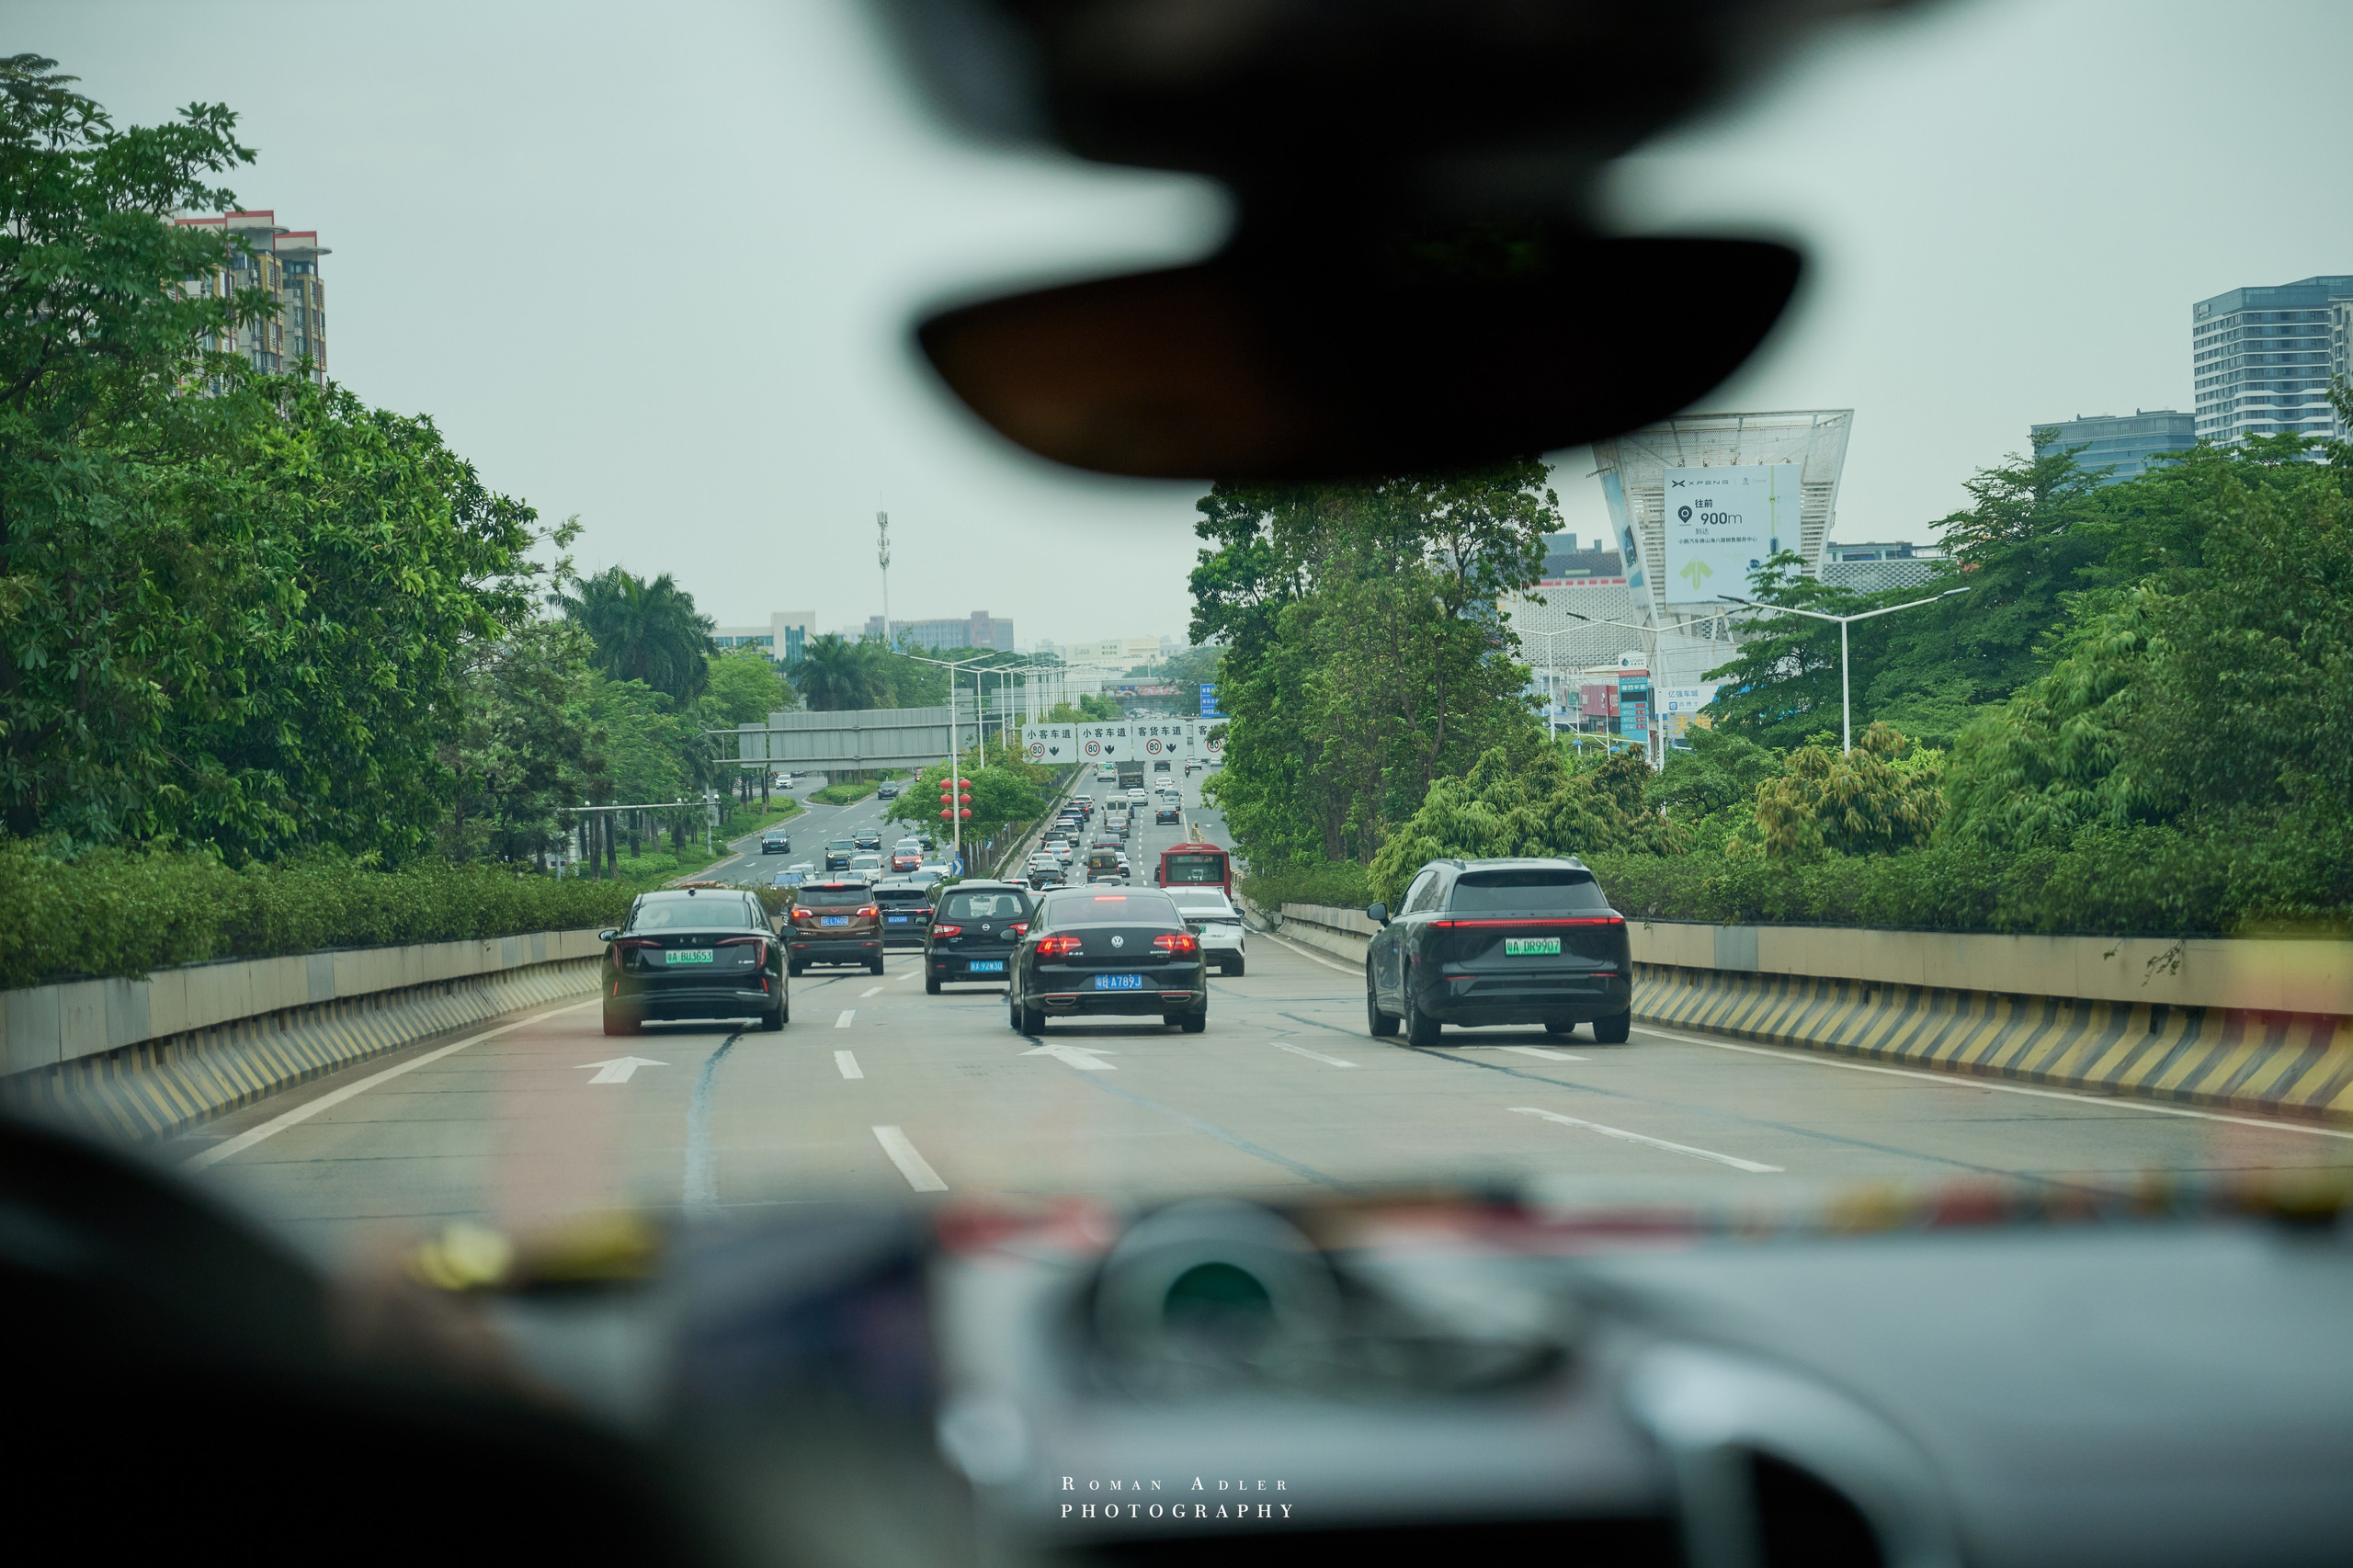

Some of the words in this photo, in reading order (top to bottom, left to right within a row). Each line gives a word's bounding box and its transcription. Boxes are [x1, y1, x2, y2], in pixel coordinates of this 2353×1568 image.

[1695, 499, 1713, 508] 往前
[1700, 512, 1743, 525] 900m
[1028, 729, 1072, 740] 小客车道
[1083, 727, 1127, 738] 小客车道
[1138, 725, 1182, 737] 客货车道
[1032, 745, 1042, 755] 80
[1087, 744, 1098, 753] 80
[1149, 743, 1160, 751] 80
